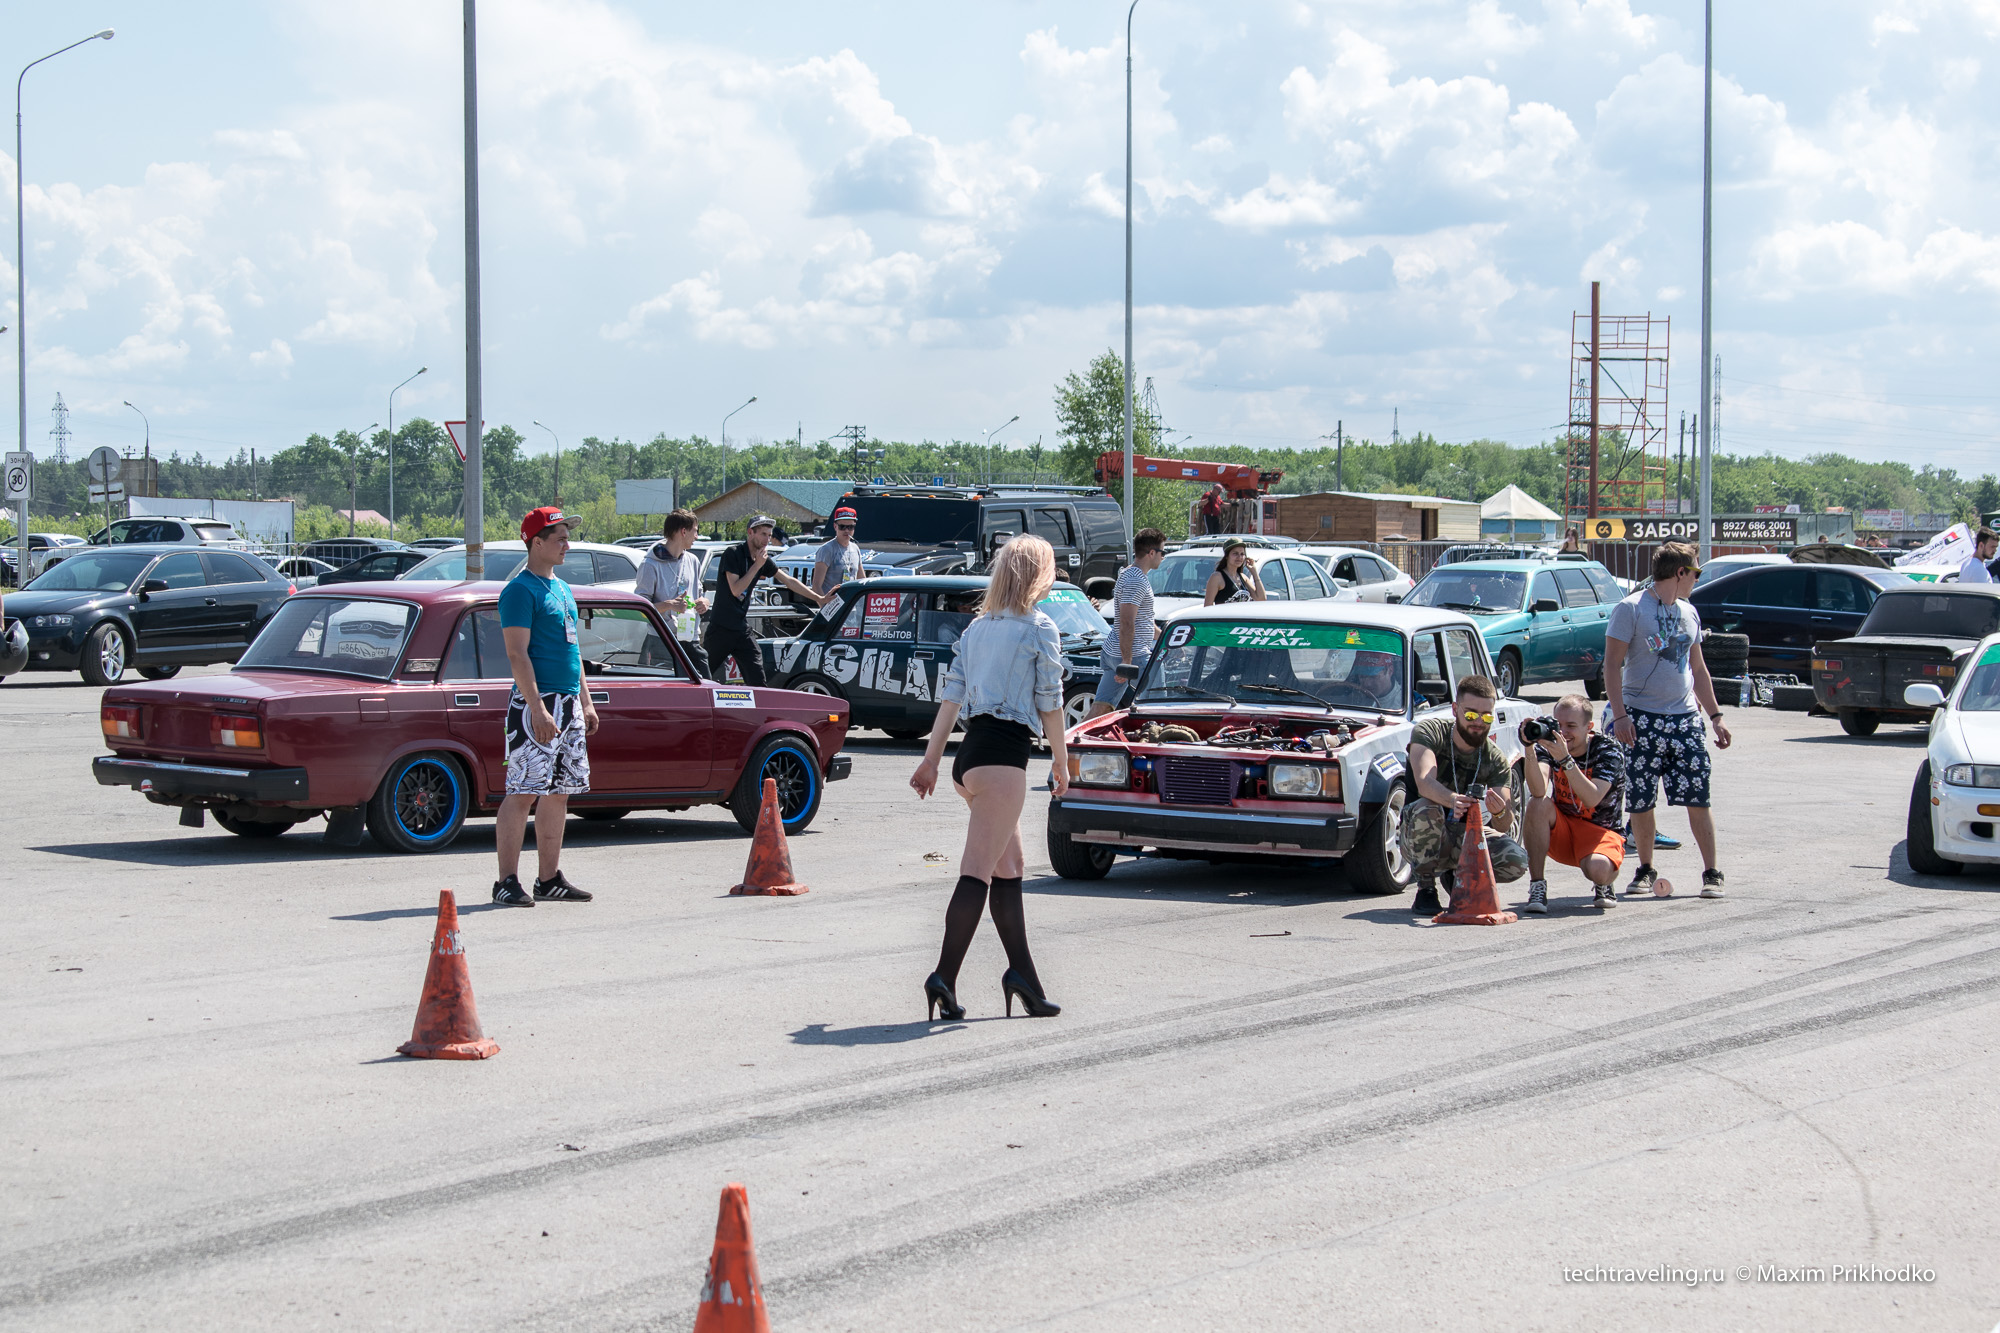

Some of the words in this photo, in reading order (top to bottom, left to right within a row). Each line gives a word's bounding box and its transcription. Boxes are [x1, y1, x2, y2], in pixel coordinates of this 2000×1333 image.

[12, 474, 23, 485] 30
[1722, 521, 1745, 530] 8927
[1749, 521, 1765, 530] 686
[1767, 521, 1791, 530] 2001
[1722, 530, 1791, 538] www.sk63.ru
[872, 630, 912, 639] ЯНЗЫТОВ
[1168, 625, 1190, 647] 8
[1229, 626, 1302, 637] DRIFT
